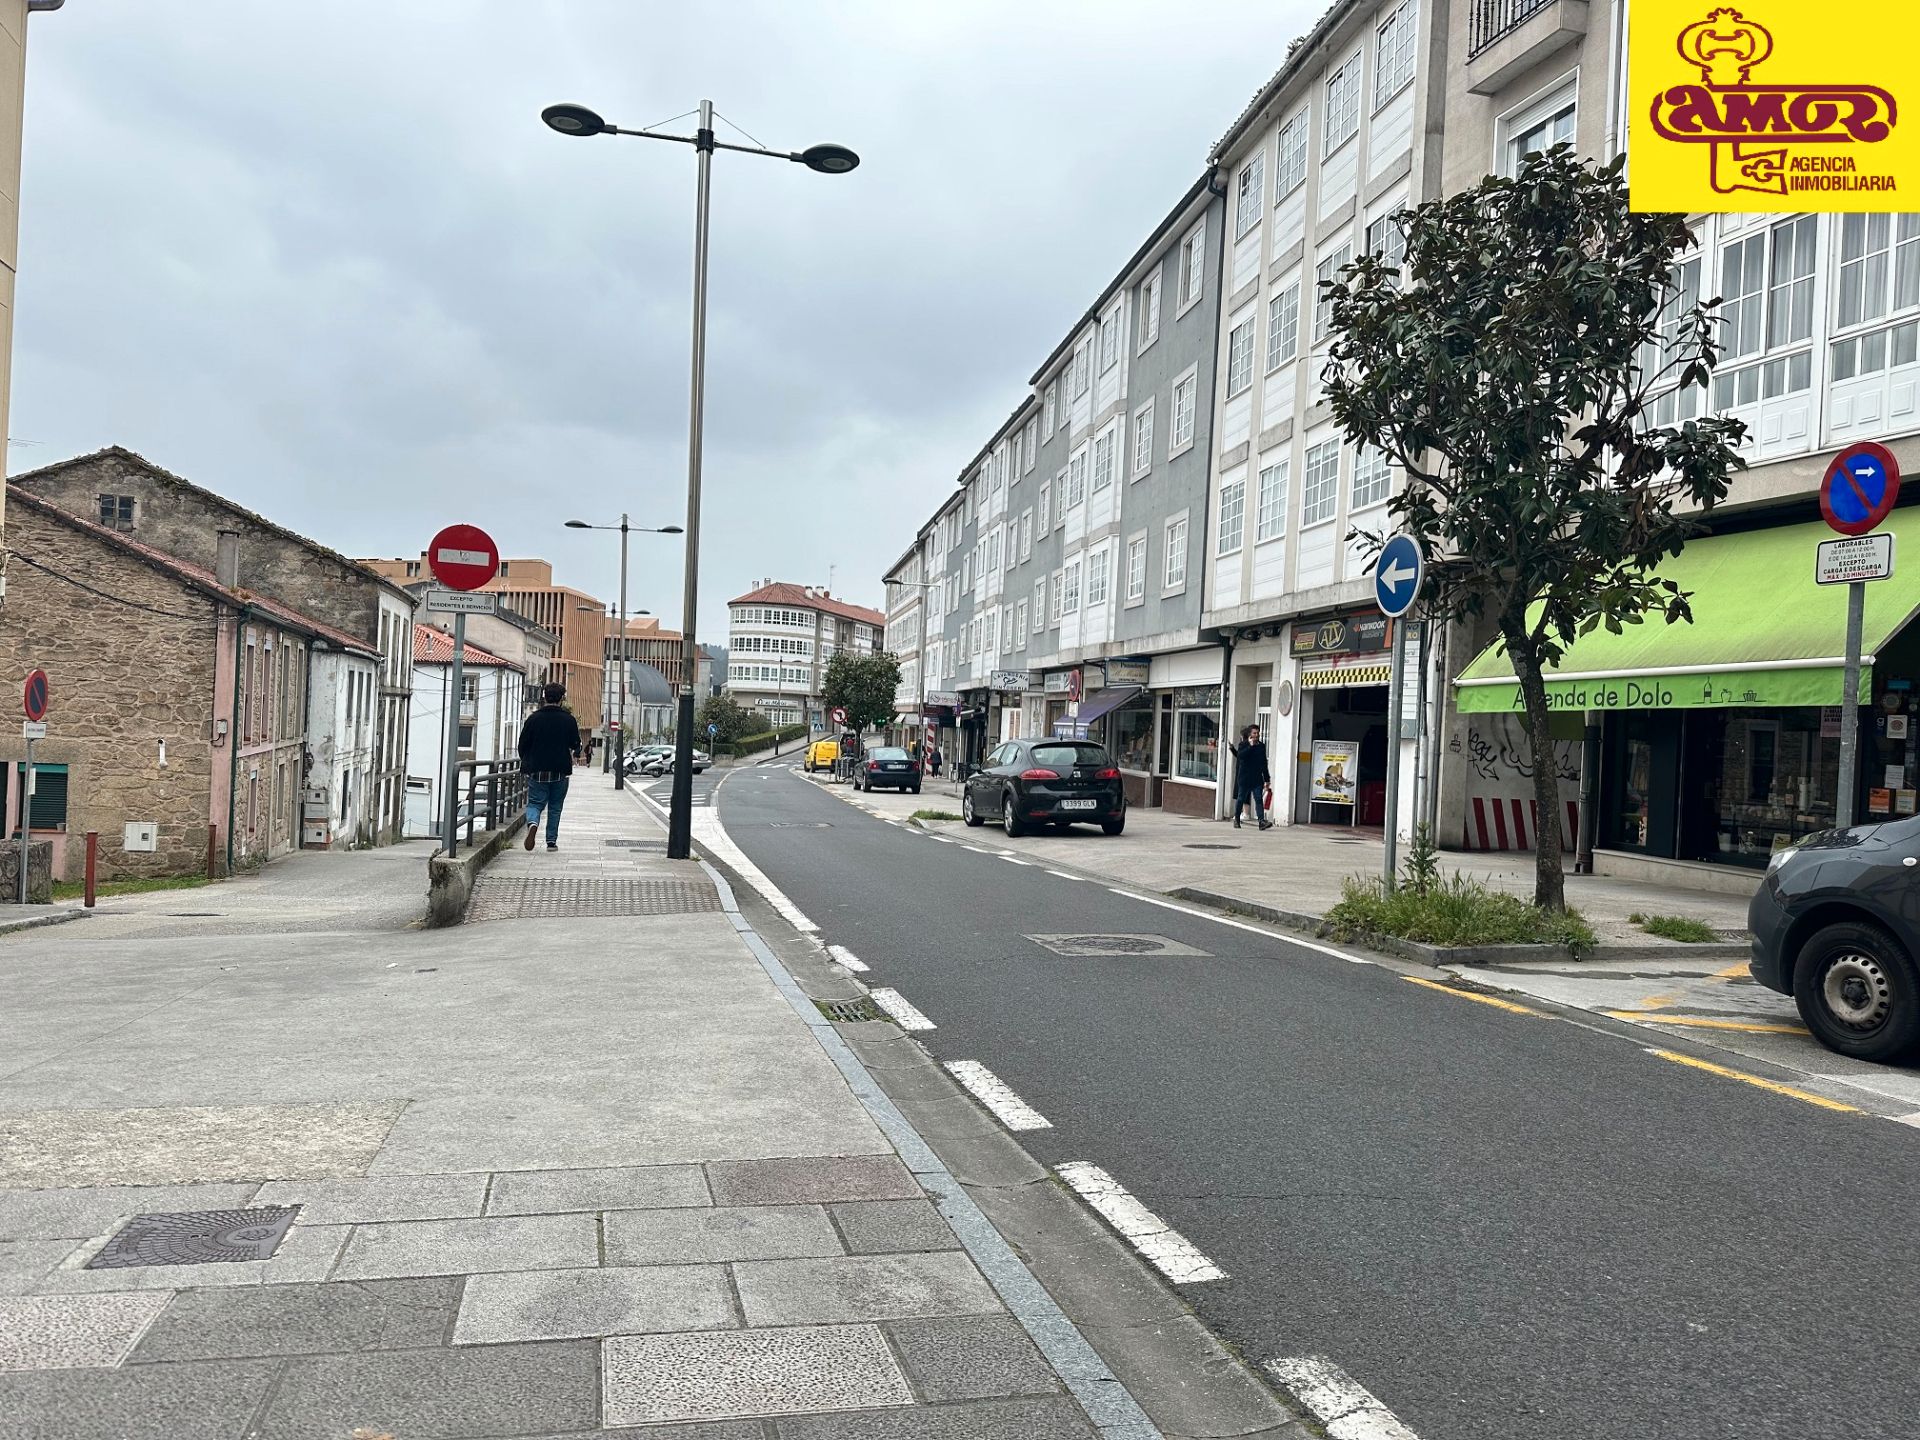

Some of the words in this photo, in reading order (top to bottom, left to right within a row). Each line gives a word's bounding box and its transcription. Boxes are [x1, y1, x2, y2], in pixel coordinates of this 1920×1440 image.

[1834, 539, 1873, 549] LABORABLES
[1839, 559, 1866, 567] EXCEPTO
[1849, 563, 1882, 572] DESCARGA
[1593, 683, 1618, 707] de
[1627, 681, 1673, 707] Dolo
